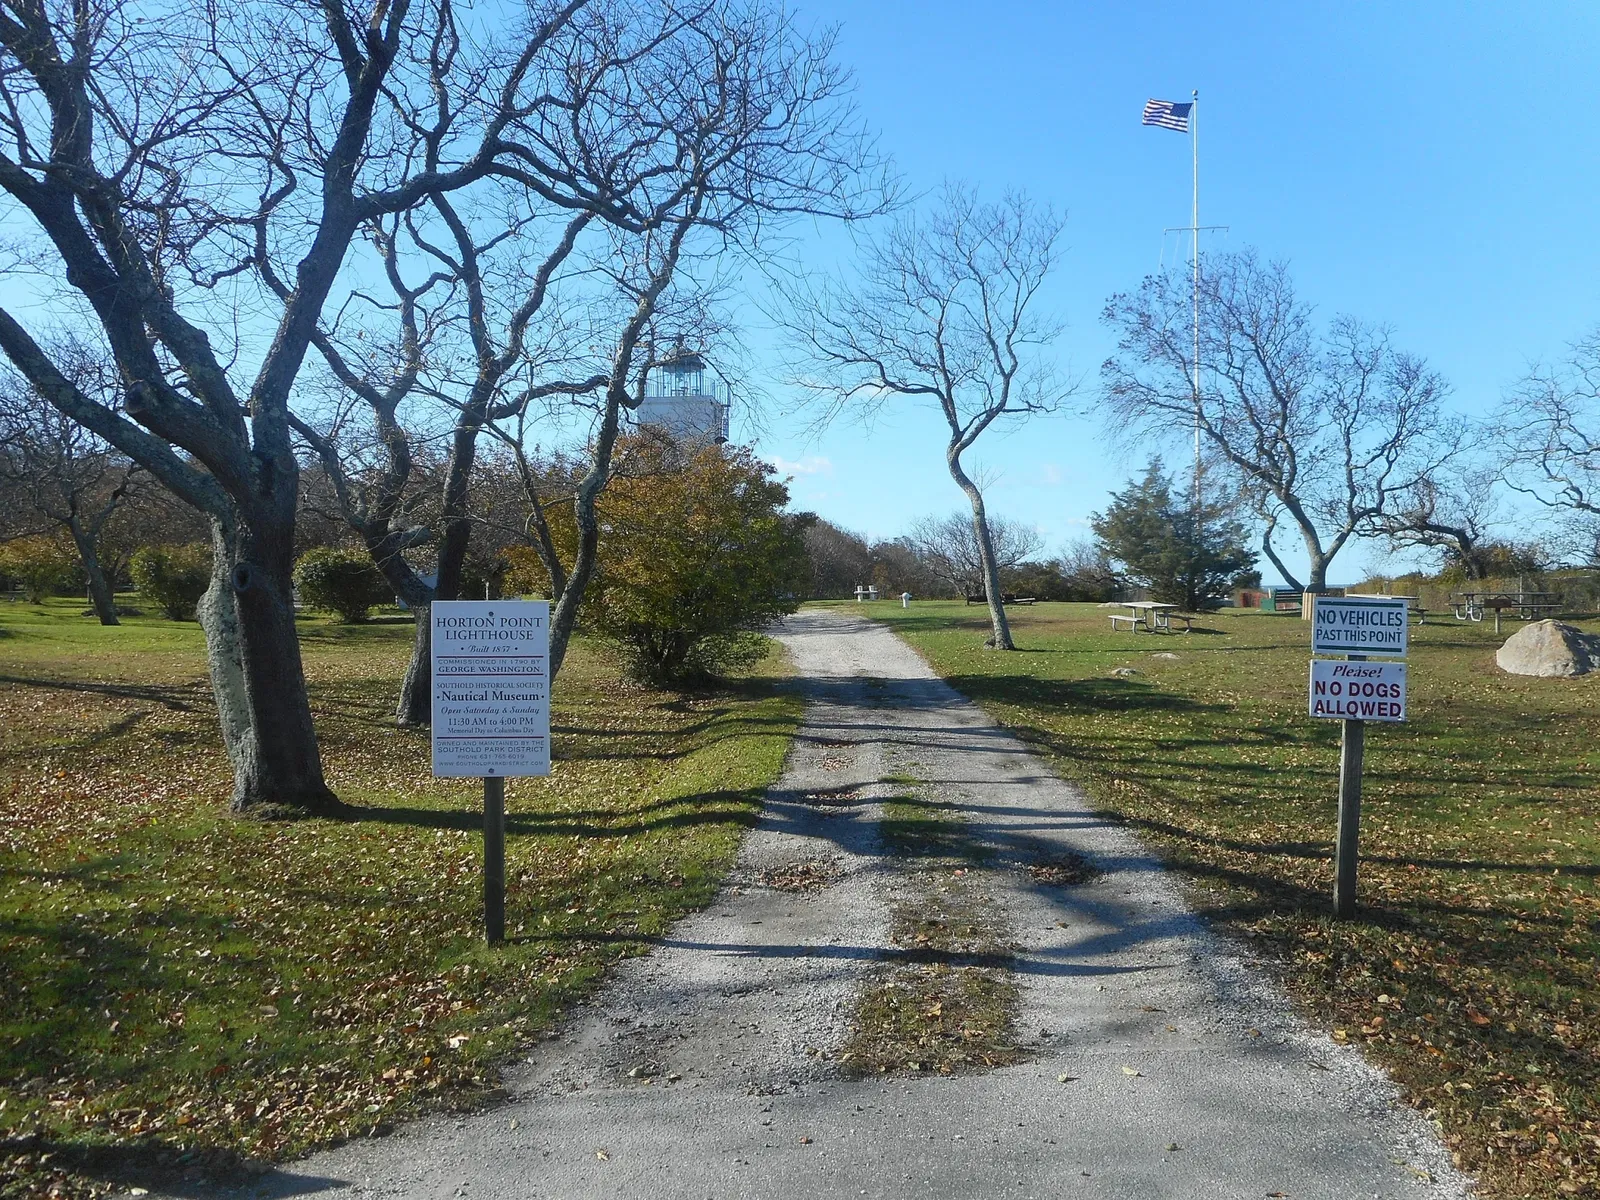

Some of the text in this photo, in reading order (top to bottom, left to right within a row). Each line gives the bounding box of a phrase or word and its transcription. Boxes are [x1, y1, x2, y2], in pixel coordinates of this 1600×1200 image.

[437, 618, 542, 627] HORTON POINT
[1317, 609, 1403, 626] NO VEHICLES
[446, 630, 534, 640] LIGHTHOUSE
[1316, 628, 1402, 643] PAST THIS POINT
[1332, 665, 1383, 678] Please!
[1314, 681, 1401, 698] NO DOGS
[442, 691, 539, 701] Nautical Museum
[441, 707, 461, 715] Open
[463, 707, 499, 715] Saturday
[510, 706, 540, 714] Sunday
[1314, 699, 1402, 717] ALLOWED
[500, 717, 516, 725] 4:00
